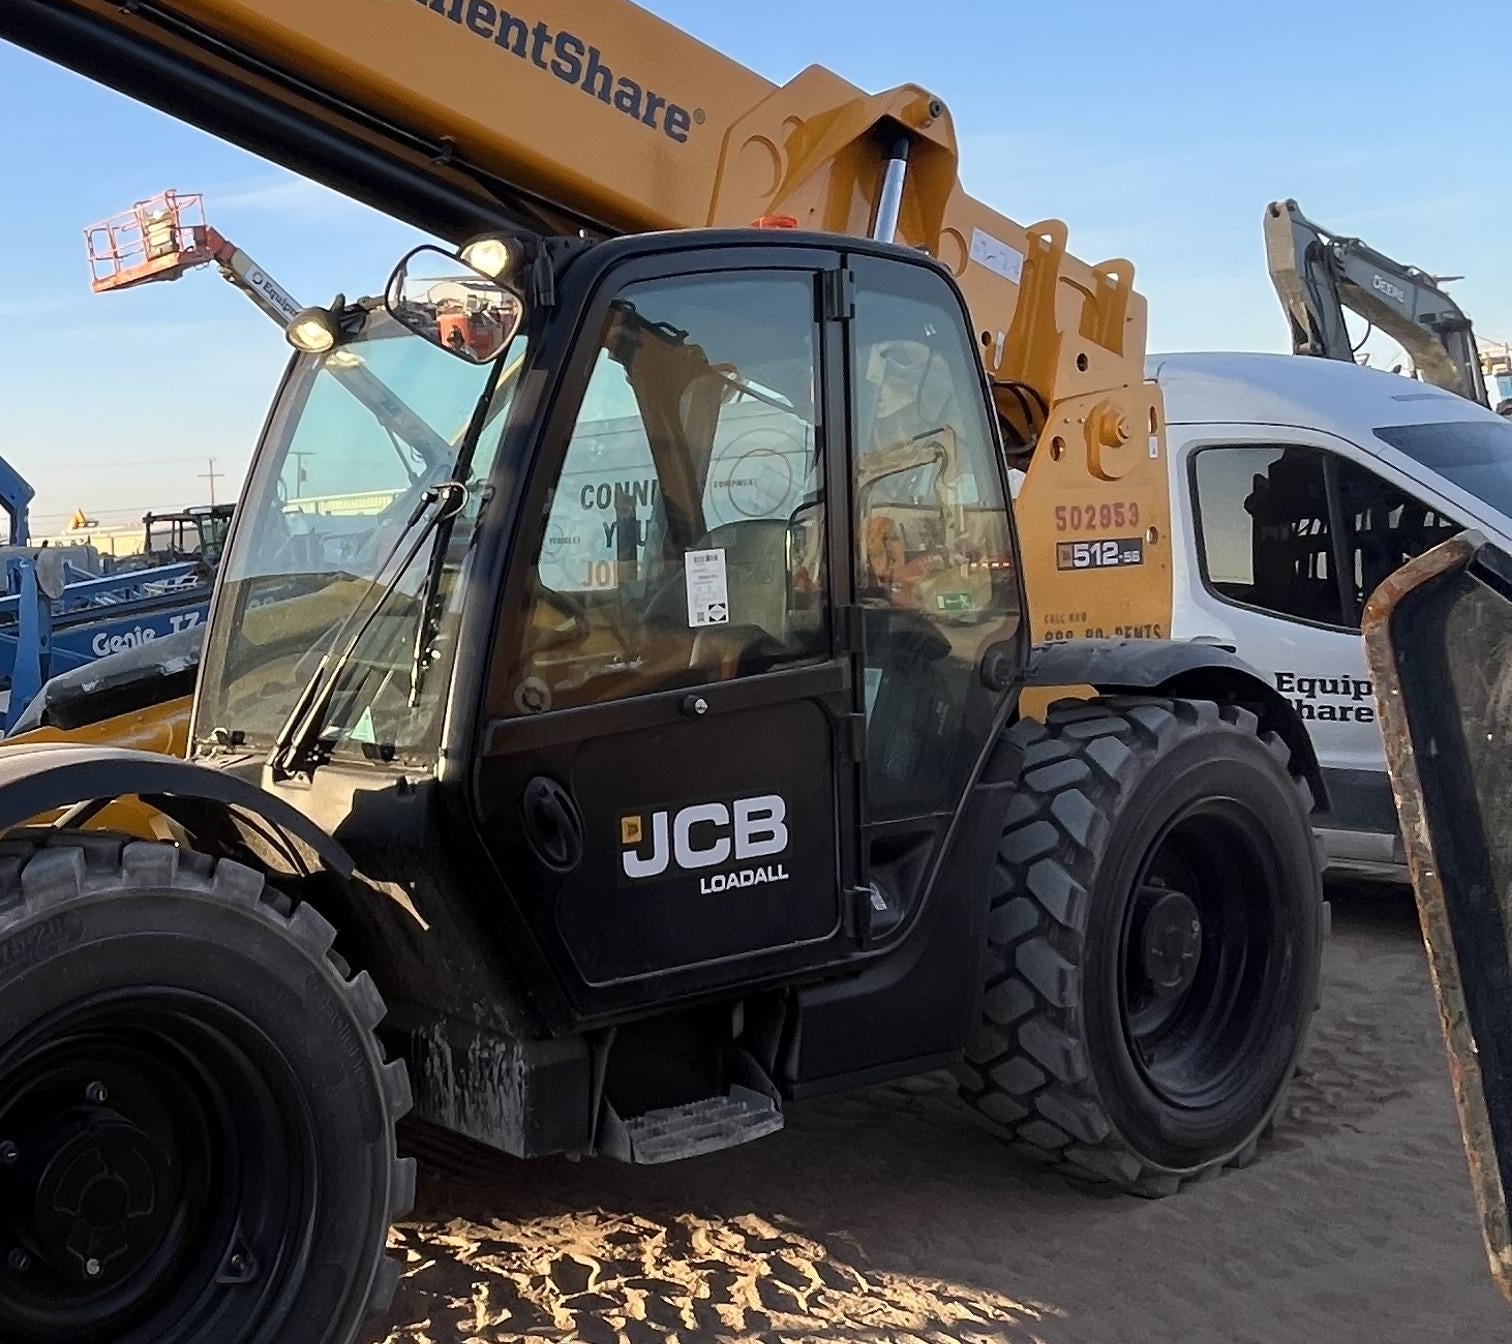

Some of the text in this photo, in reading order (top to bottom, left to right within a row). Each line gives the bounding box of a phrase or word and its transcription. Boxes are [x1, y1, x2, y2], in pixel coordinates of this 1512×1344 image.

[1373, 274, 1405, 304] DEERE
[92, 625, 156, 657] Genie
[1289, 698, 1374, 723] hare
[622, 794, 788, 879] JCB
[700, 864, 790, 895] LOADALL
